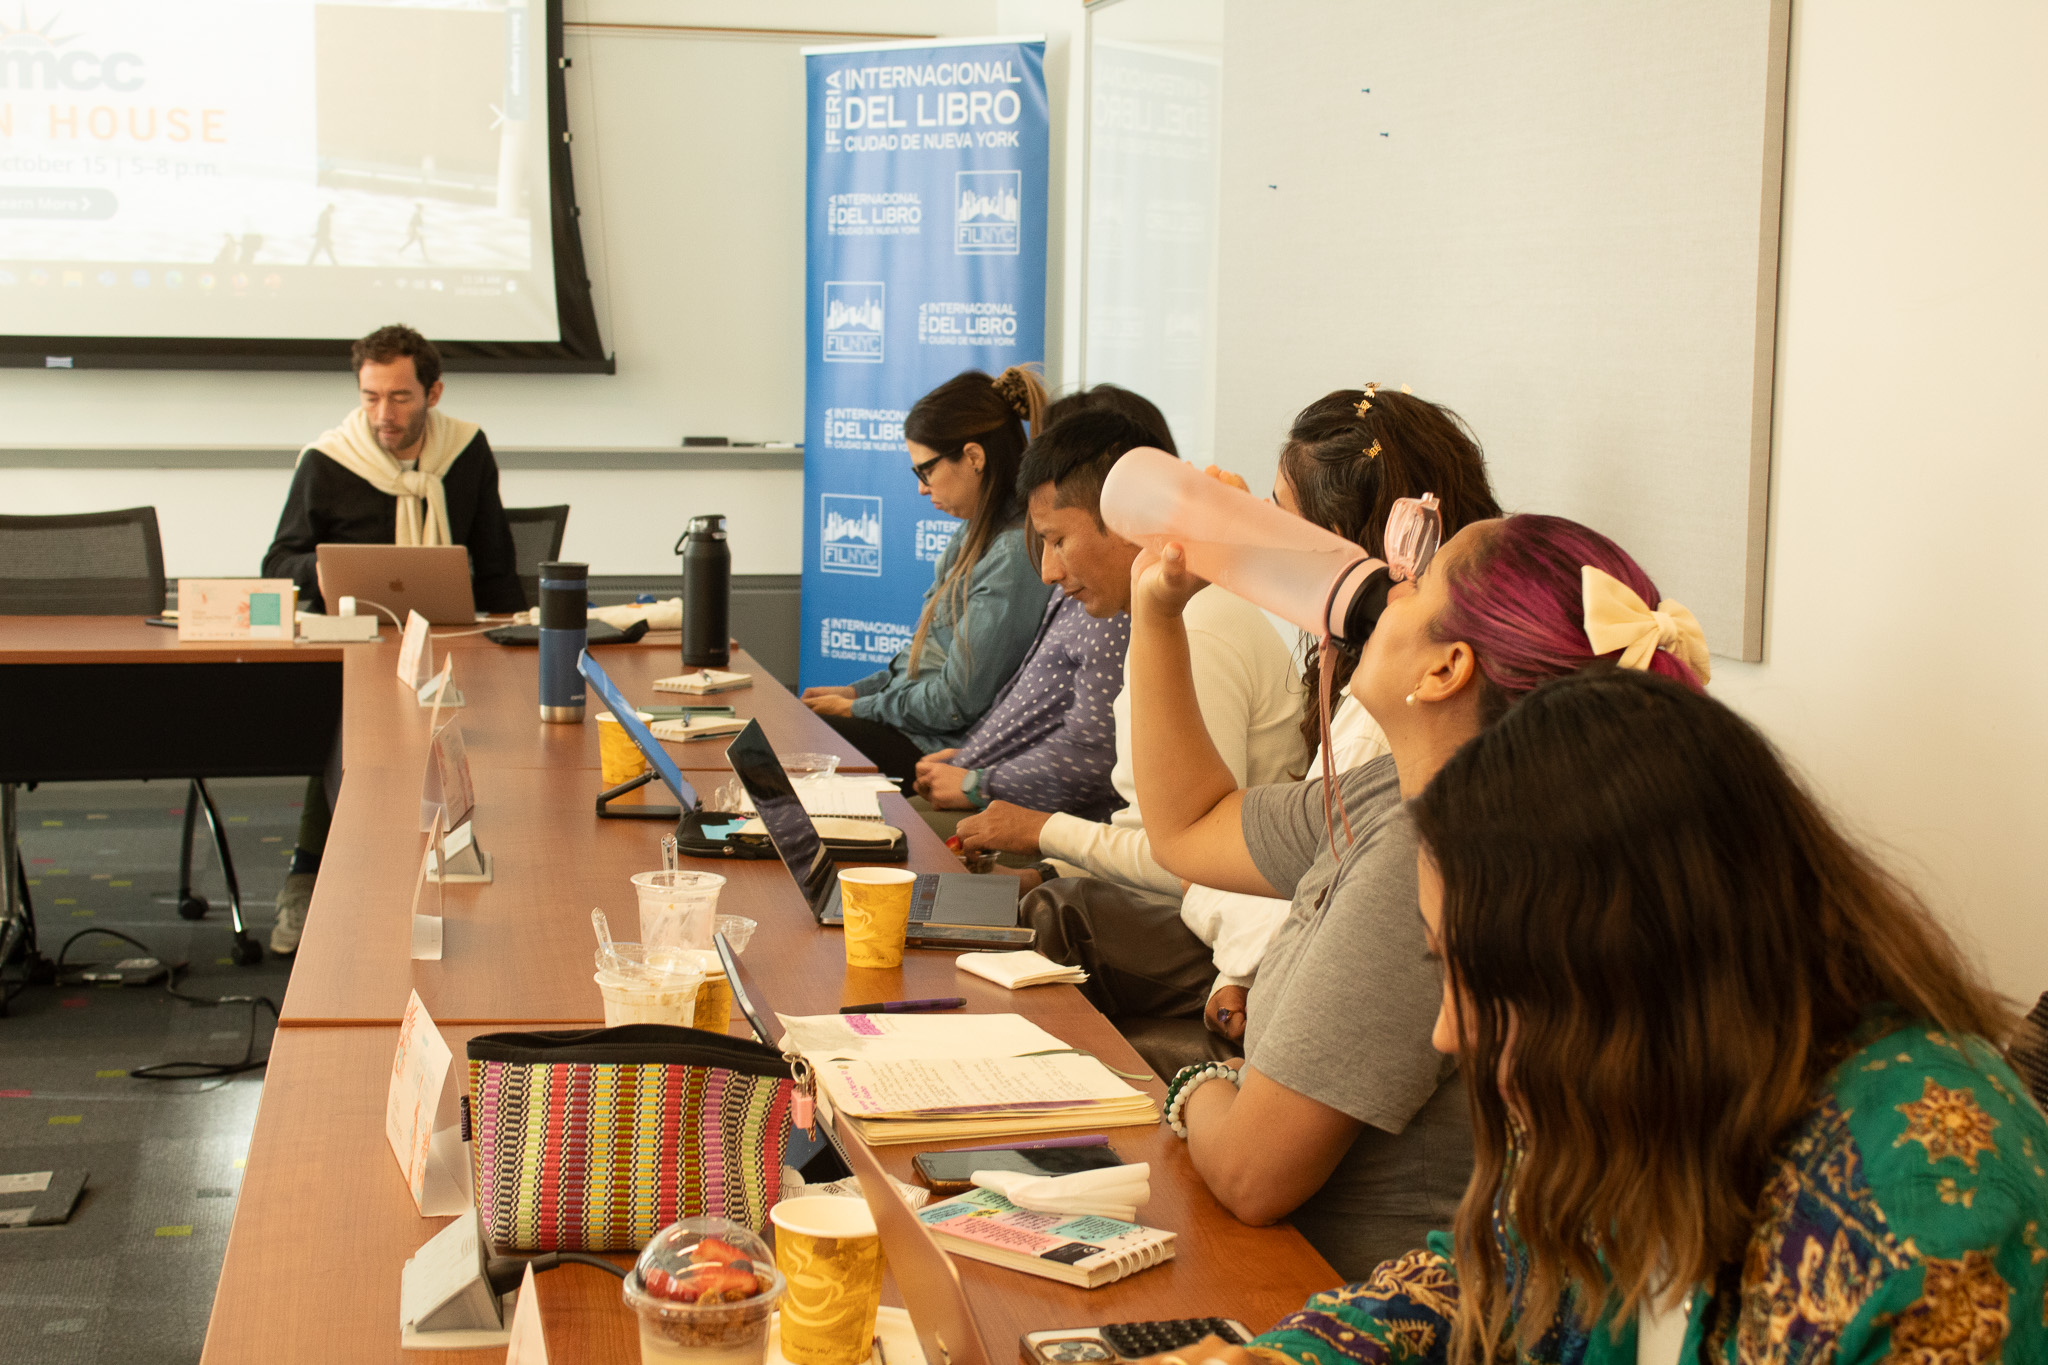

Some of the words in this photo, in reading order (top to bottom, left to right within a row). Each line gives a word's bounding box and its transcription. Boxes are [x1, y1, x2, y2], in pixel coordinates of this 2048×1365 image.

[845, 60, 1022, 90] INTERNACIONAL
[825, 69, 842, 145] FERIA
[845, 95, 907, 130] DEL
[916, 89, 1022, 127] LIBRO
[48, 104, 228, 144] HOUSE
[844, 134, 898, 152] CIUDAD
[901, 133, 920, 150] DE
[923, 132, 972, 149] NUEVA
[976, 130, 1020, 148] YORK
[83, 156, 107, 175] 15
[838, 192, 921, 205] INTERNACIONAL
[837, 207, 868, 225] DEL
[872, 206, 922, 224] LIBRO
[959, 227, 1015, 243] FILNYC
[928, 302, 1017, 316] INTERNACIONAL
[928, 316, 961, 334] DEL
[965, 316, 1017, 335] LIBRO
[827, 335, 880, 353] FILNYC
[834, 407, 908, 421] INTERNACION
[834, 421, 866, 439] DEL
[869, 422, 905, 440] LIBR
[825, 546, 877, 566] FILNYC
[831, 617, 914, 637] INTERNACIONAL
[831, 631, 862, 650] DEL
